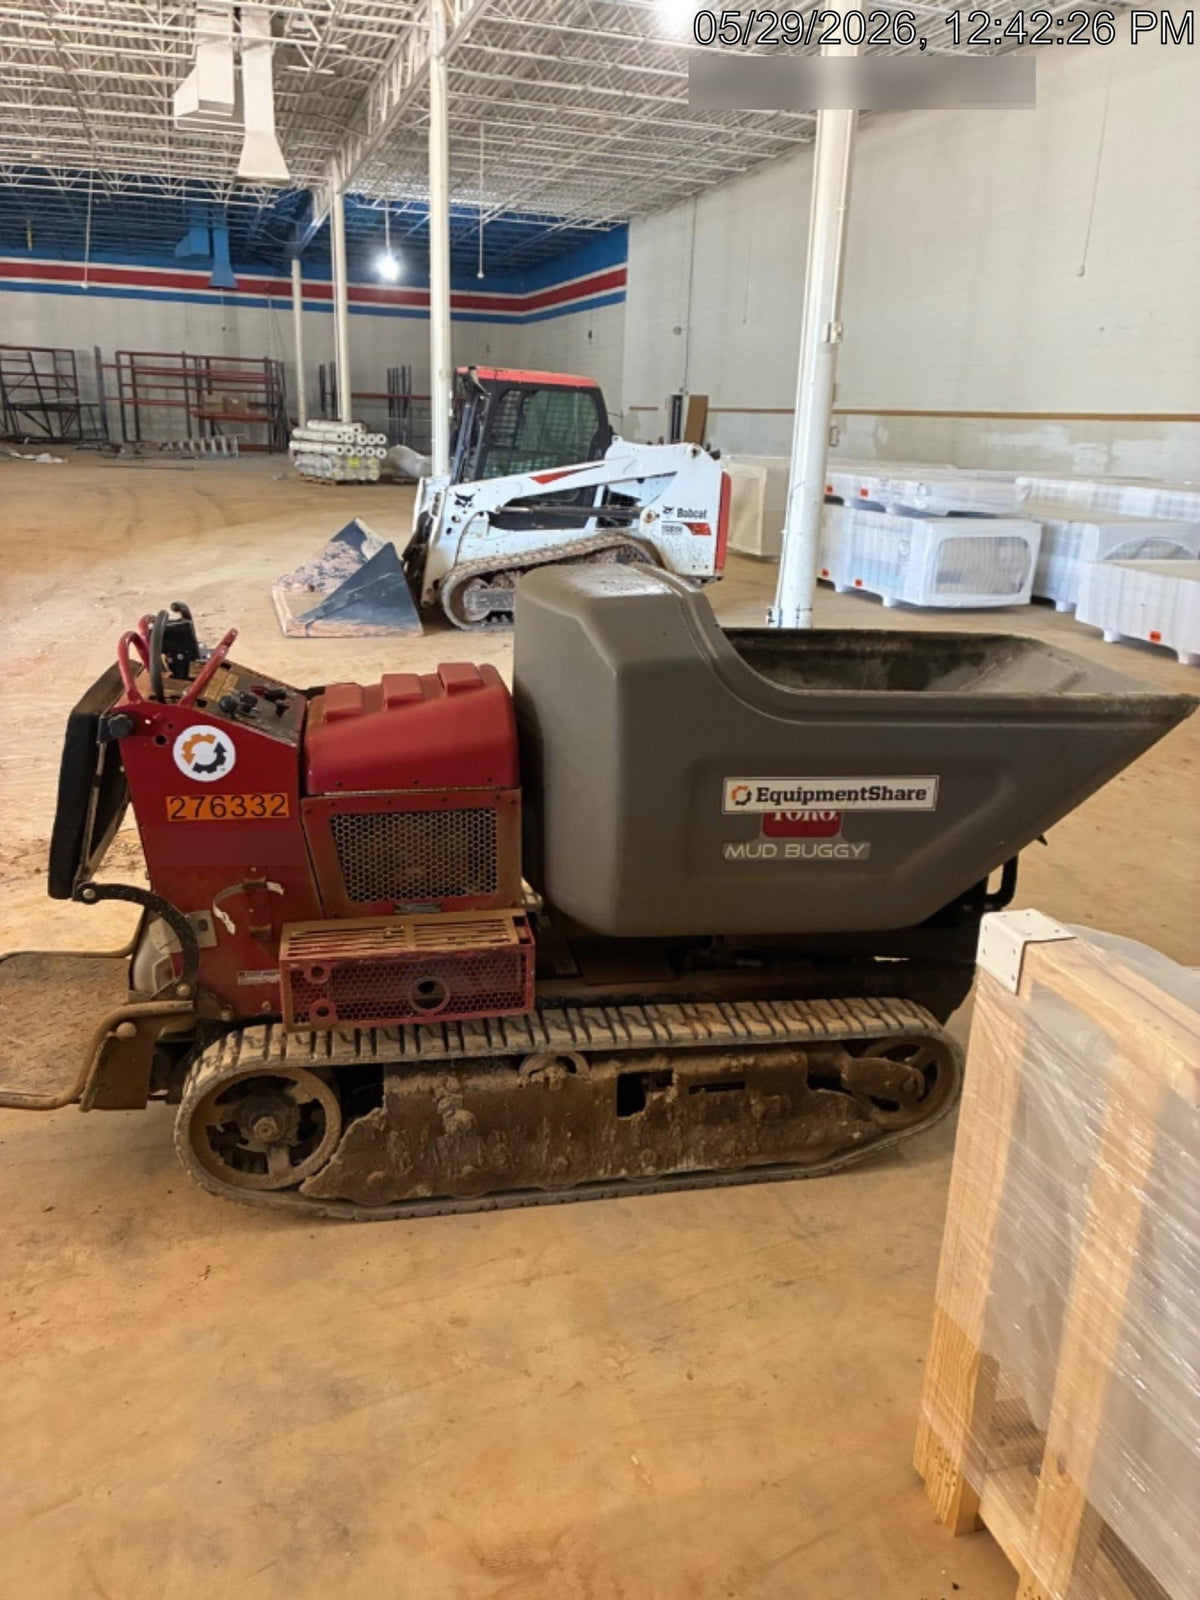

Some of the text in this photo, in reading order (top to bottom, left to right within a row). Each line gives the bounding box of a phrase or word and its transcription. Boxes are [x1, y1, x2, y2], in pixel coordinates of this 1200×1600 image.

[677, 507, 708, 519] Bobcat
[755, 785, 927, 806] EquipmentShare
[169, 794, 287, 819] 276332
[724, 842, 866, 859] MUD BUGGY
